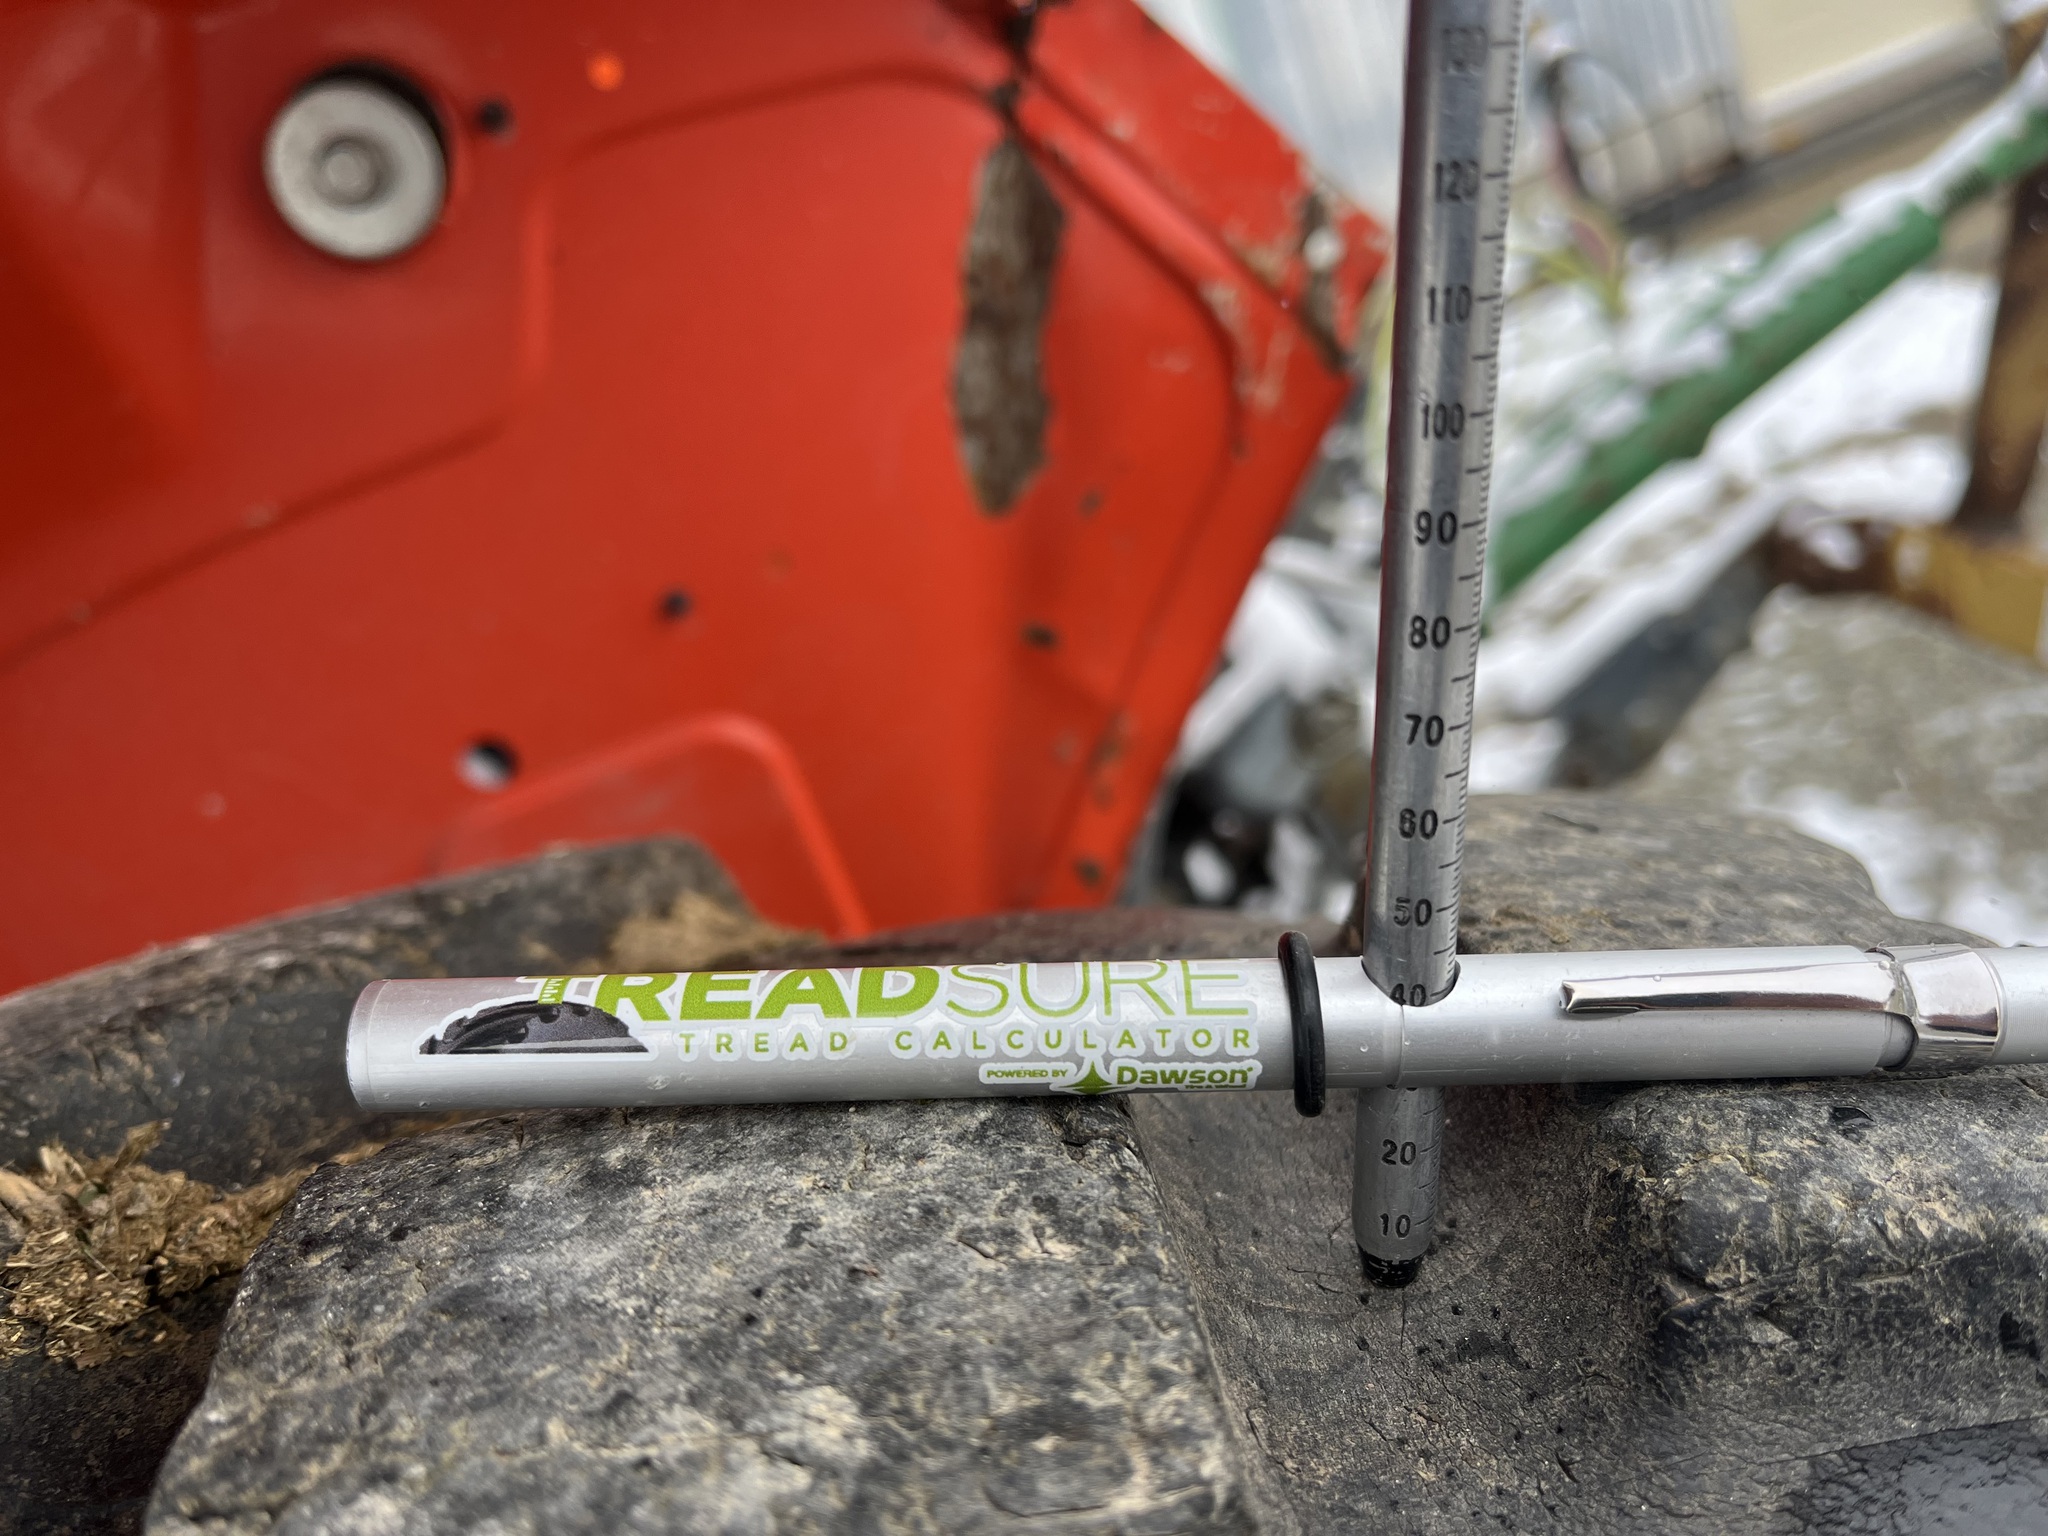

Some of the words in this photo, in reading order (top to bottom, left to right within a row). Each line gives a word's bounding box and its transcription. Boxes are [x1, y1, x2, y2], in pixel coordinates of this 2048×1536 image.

[1434, 159, 1480, 203] 120
[1428, 284, 1472, 324] 110
[1422, 402, 1465, 439] 100
[1416, 510, 1457, 546] 90
[1409, 615, 1451, 649] 80
[1404, 713, 1444, 747] 70
[1399, 808, 1438, 840] 60
[1393, 896, 1432, 927] 50
[1390, 983, 1427, 1007] 40
[678, 1031, 849, 1054] TREAD
[895, 1028, 1253, 1052] CALCULATOR
[986, 1069, 1049, 1078] POWERED
[1051, 1068, 1068, 1077] BY
[1117, 1065, 1248, 1085] Dawson
[1381, 1138, 1417, 1166] 20
[1379, 1212, 1411, 1239] 10
